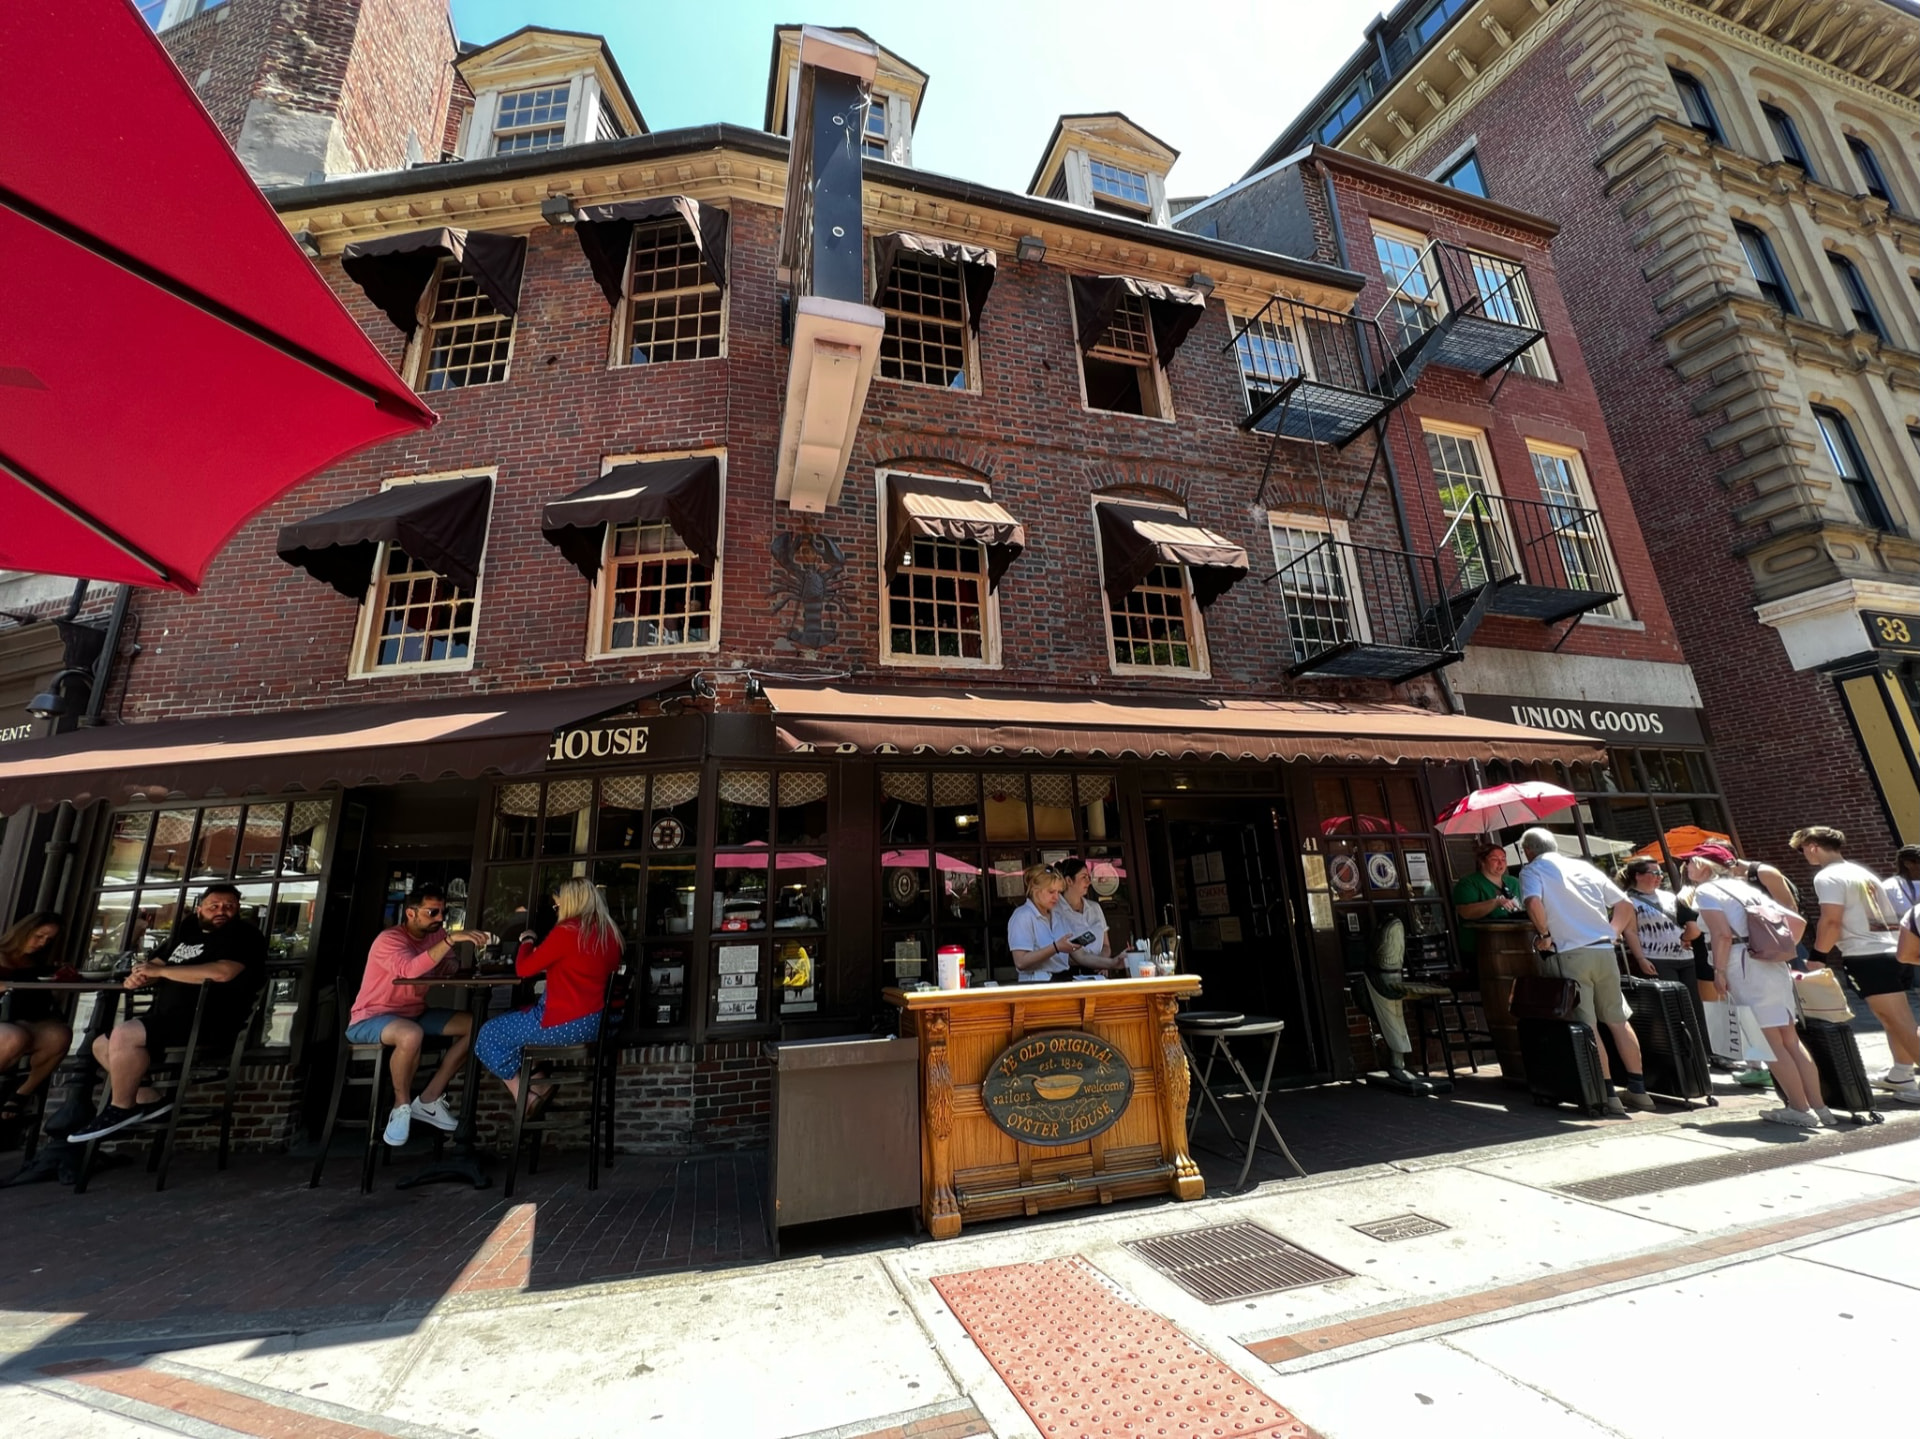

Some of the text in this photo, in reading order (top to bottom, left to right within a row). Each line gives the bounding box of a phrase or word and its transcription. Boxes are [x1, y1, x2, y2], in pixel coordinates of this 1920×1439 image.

[1876, 616, 1911, 644] 33
[0, 723, 32, 742] ENTS
[1511, 705, 1664, 734] UNION GOODS
[1302, 836, 1319, 852] 41
[1000, 1038, 1113, 1077] YE OLD ORIGINAL
[1039, 1058, 1084, 1072] est. 1826
[992, 1080, 1125, 1105] sailors welcome
[1007, 1101, 1113, 1137] OYSTER HOUSE
